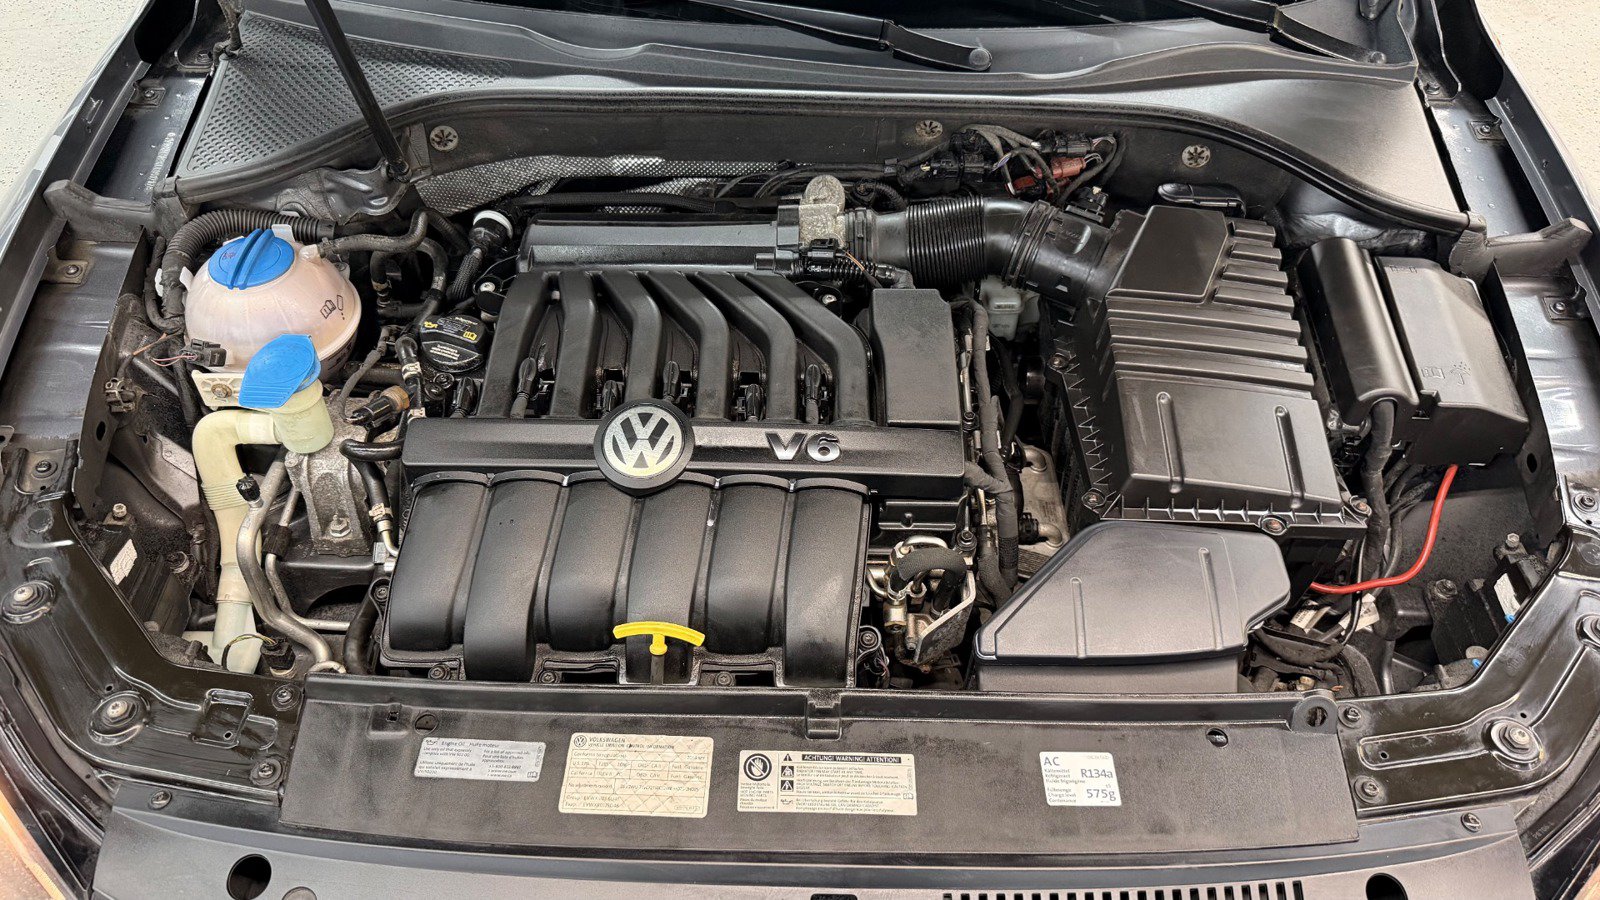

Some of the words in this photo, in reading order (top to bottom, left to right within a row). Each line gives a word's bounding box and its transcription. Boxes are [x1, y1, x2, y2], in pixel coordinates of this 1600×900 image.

[603, 406, 685, 477] VW
[765, 432, 841, 462] V6
[1044, 756, 1060, 766] AC
[1080, 768, 1114, 778] R134a
[1086, 788, 1116, 802] 575g
